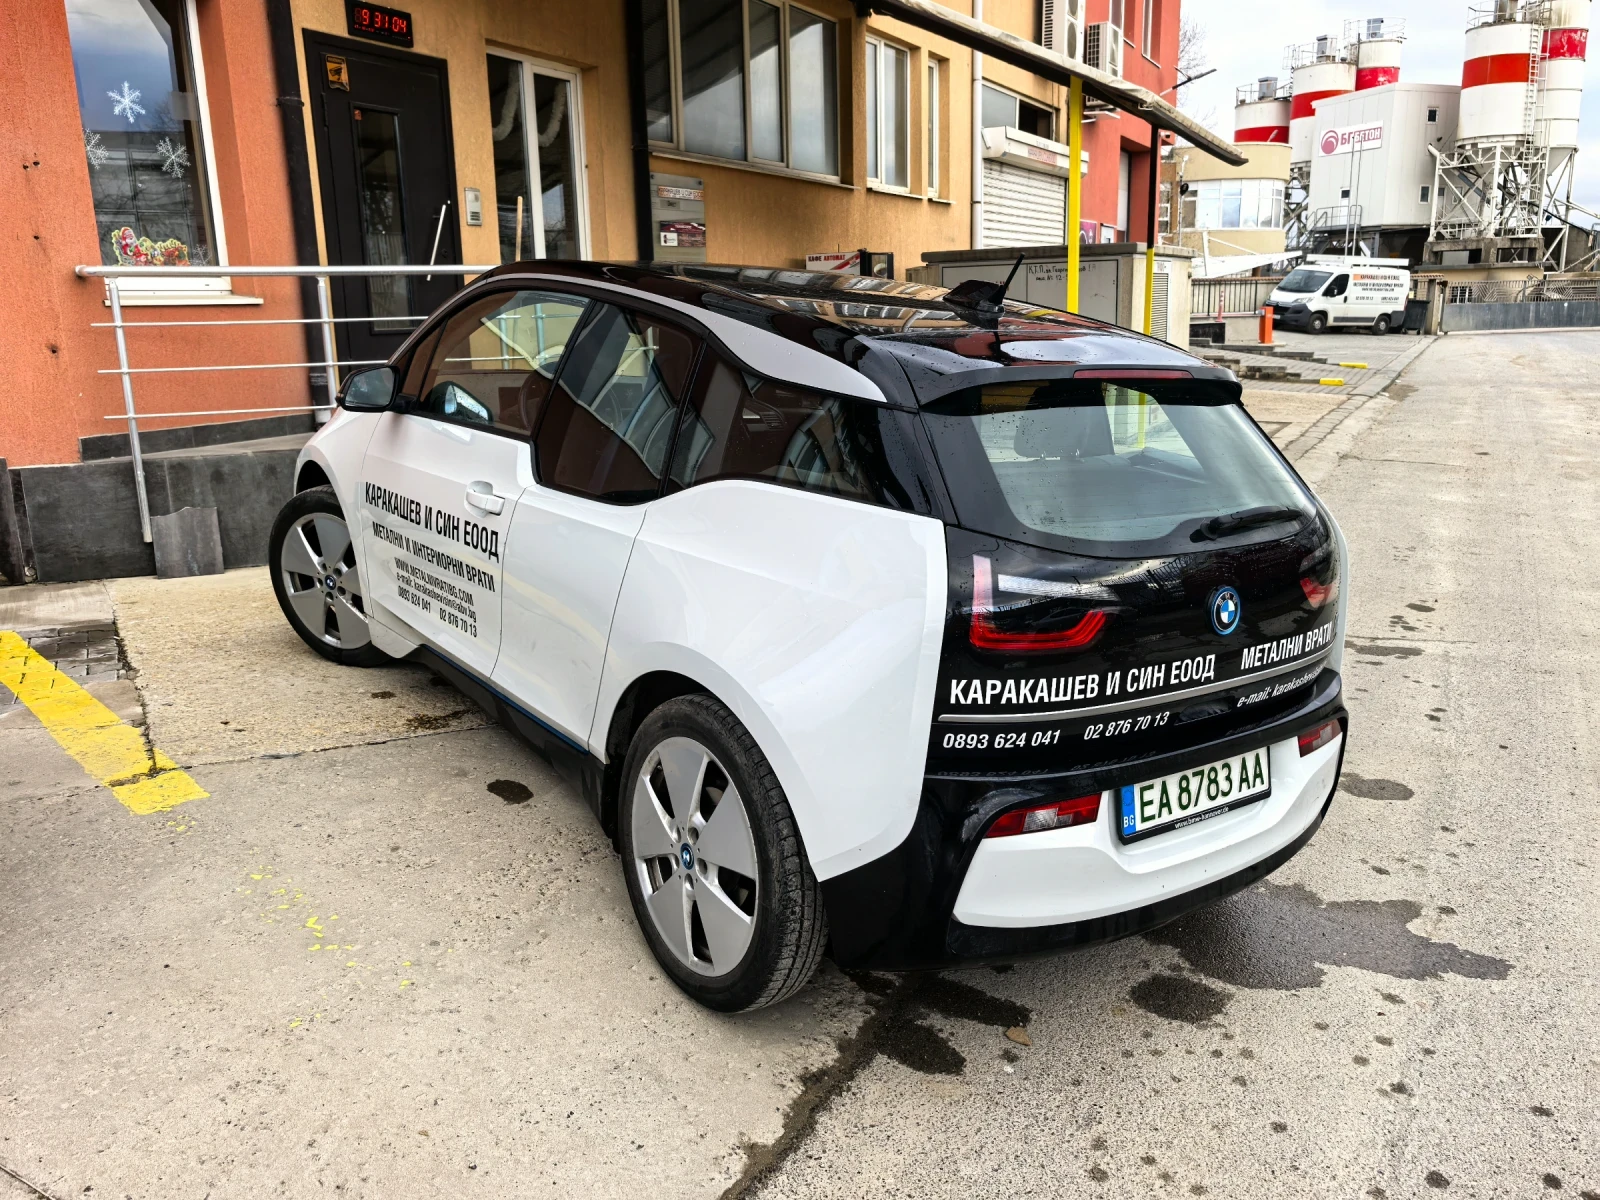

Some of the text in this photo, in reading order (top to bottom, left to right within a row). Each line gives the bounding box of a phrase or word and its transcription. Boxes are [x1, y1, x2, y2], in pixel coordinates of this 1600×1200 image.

[365, 481, 500, 564] КАРАКАШЕВ И СИН ЕООД
[372, 520, 496, 593] МЕТАЛНИ И ИНТЕРИОРНИ ВРАТИ
[397, 585, 431, 614] 0893 624 041
[439, 607, 478, 638] 02 876 70 13
[1240, 620, 1334, 670] МЕТАЛНИ ВРАТИ
[949, 653, 1217, 705] КАРАКАШЕВ И СИН ЕООД
[1236, 685, 1272, 708] e-mail:
[942, 729, 1061, 749] 0893 624 041
[1083, 710, 1171, 741] 02 876 70 13
[1139, 752, 1265, 824] EA 8783 AA
[1123, 816, 1135, 828] BG
[1174, 805, 1230, 830] www.bmw-hannover.de
